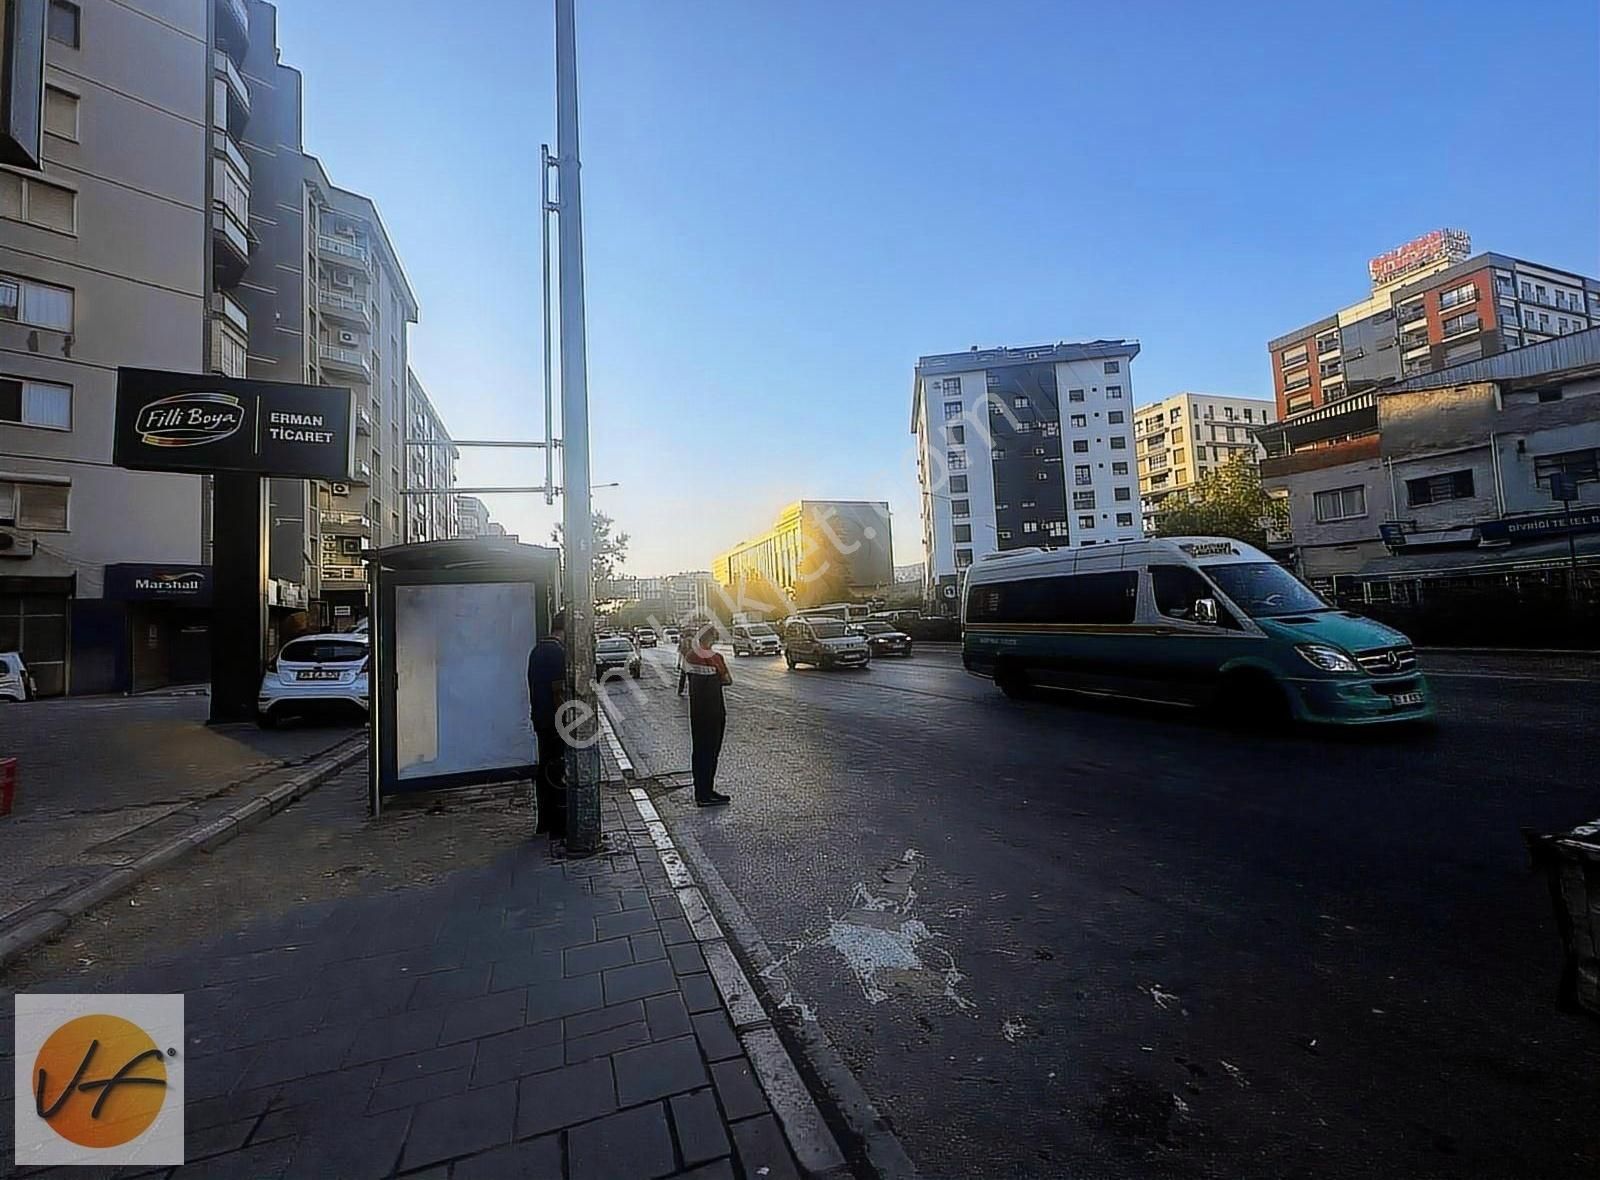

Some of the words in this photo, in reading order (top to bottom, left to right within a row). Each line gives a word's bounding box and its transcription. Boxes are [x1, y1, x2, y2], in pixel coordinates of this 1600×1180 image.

[146, 407, 184, 428] Filli
[187, 408, 236, 430] Boya
[270, 412, 323, 426] ERMAN
[269, 426, 334, 443] TİCARET
[135, 579, 199, 589] Marshall
